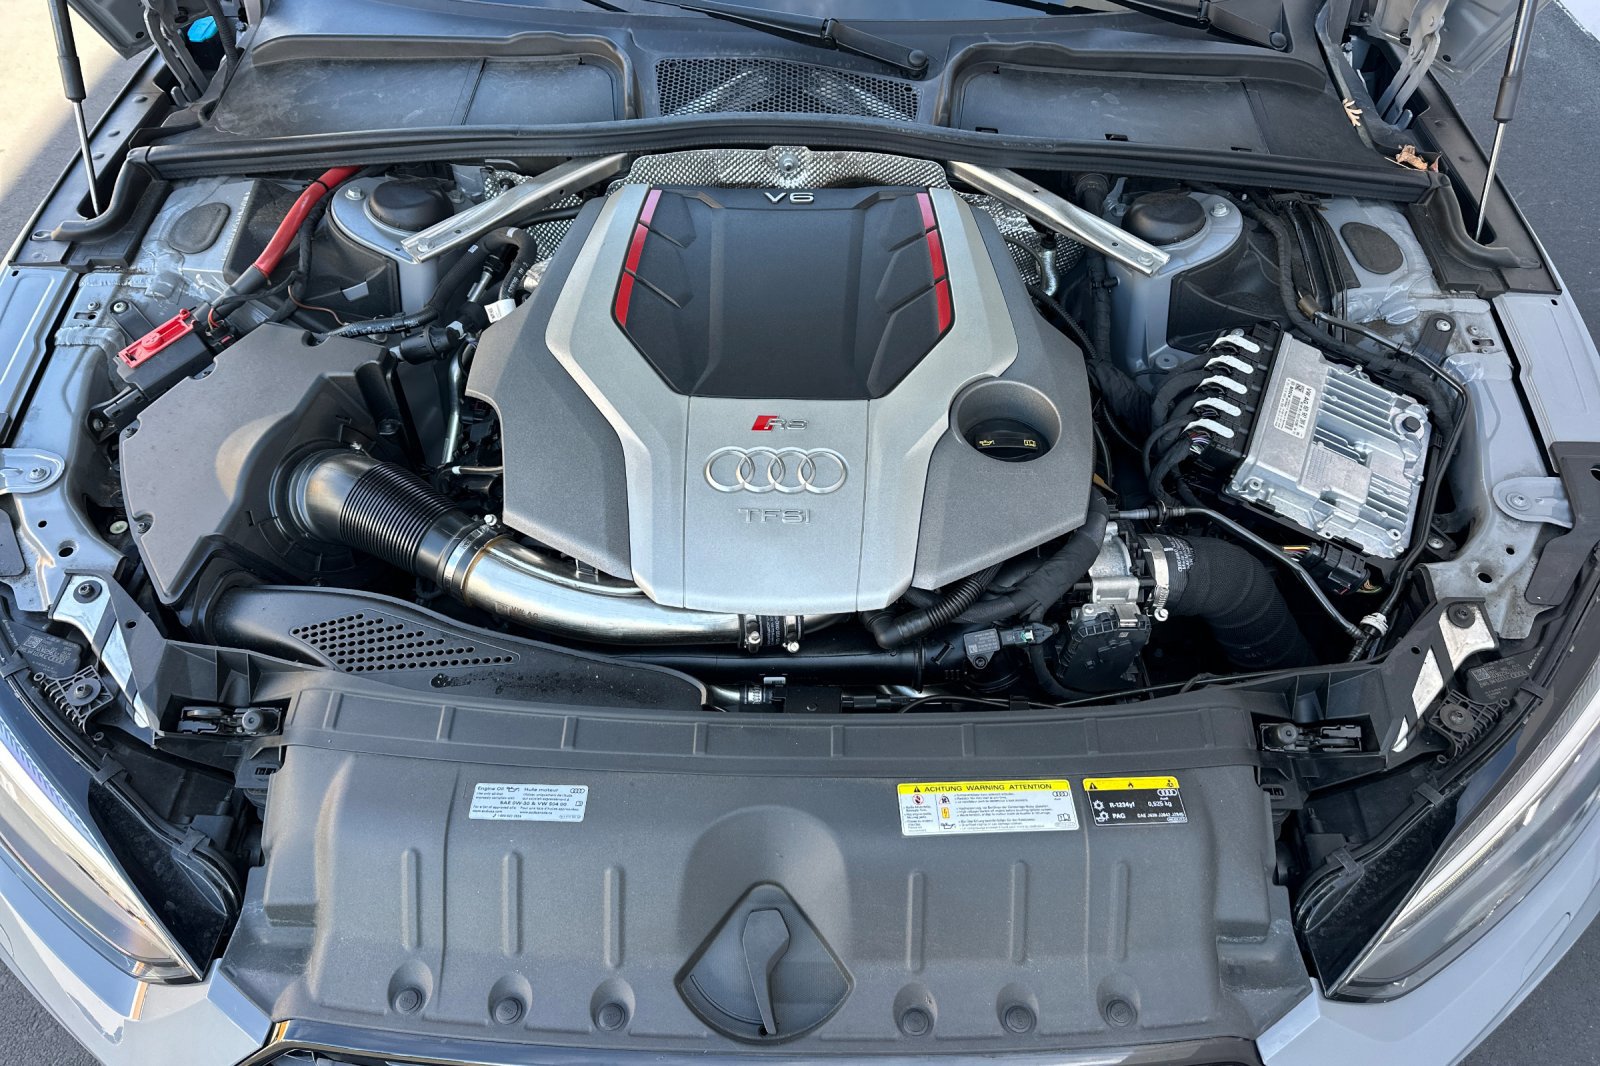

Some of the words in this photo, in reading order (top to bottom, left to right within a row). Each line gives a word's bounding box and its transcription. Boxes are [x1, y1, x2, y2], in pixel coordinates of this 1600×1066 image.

[764, 192, 815, 204] V6
[763, 418, 809, 431] RS
[738, 508, 812, 525] TFSI
[924, 785, 963, 793] ACHTUNG
[965, 784, 1005, 792] WARNING
